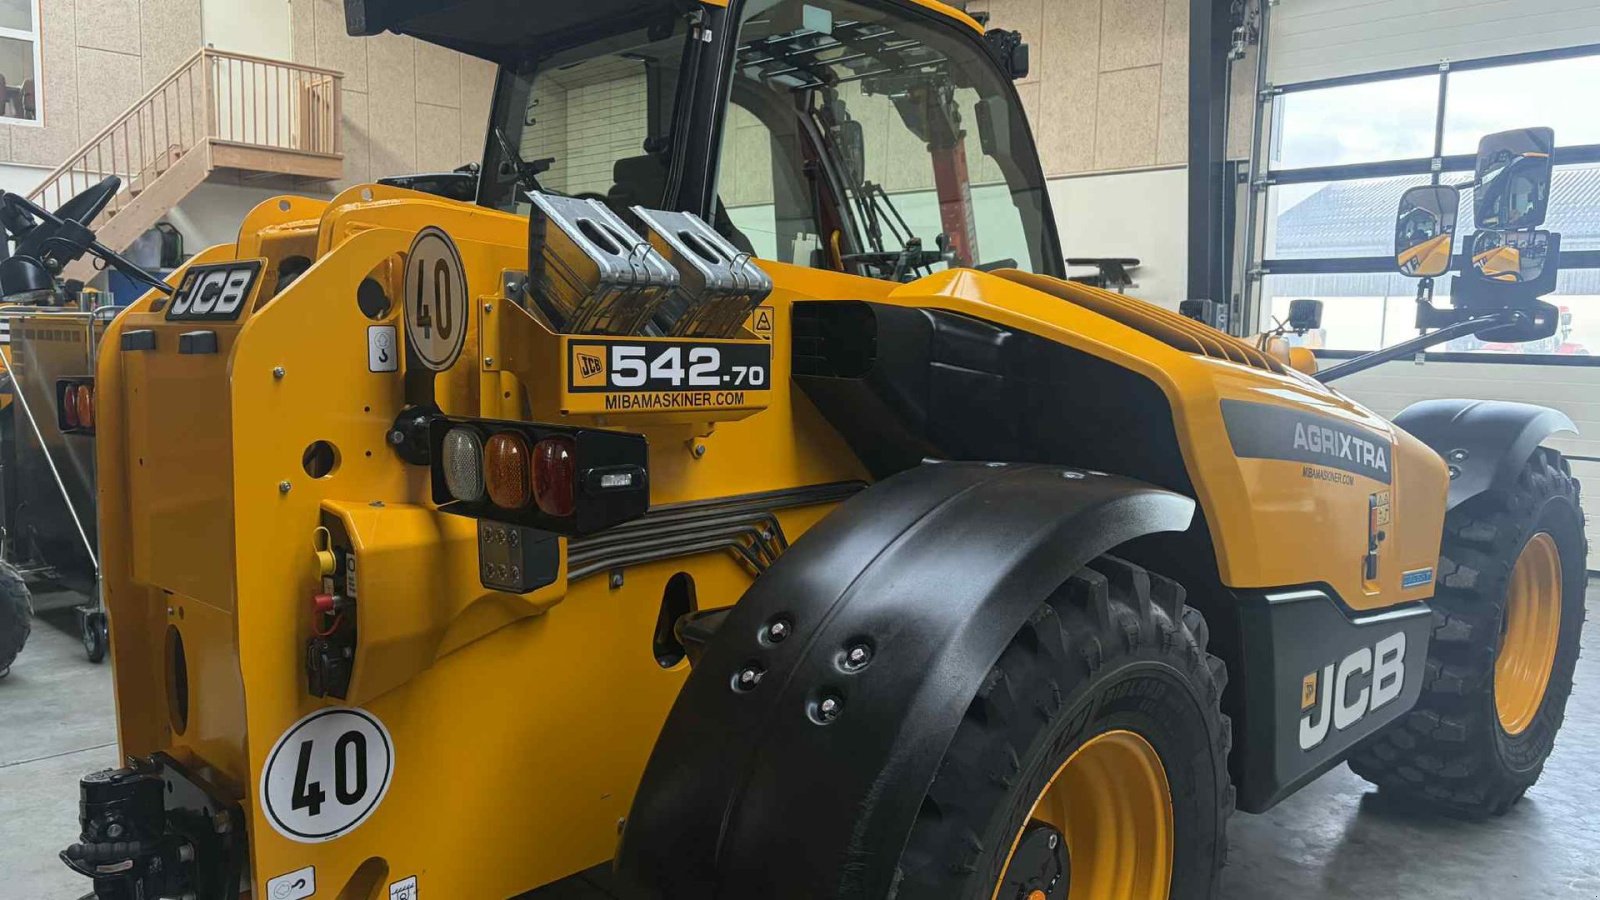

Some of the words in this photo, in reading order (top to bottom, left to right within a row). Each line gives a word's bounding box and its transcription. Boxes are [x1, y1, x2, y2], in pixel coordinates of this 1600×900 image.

[172, 271, 252, 315] JCB
[417, 258, 452, 340] 40
[581, 356, 601, 375] JCB
[605, 392, 745, 409] MIBAMASKINER.COM
[1293, 422, 1387, 473] AGRIXTRA
[1299, 631, 1406, 750] JCB
[291, 730, 368, 817] 40
